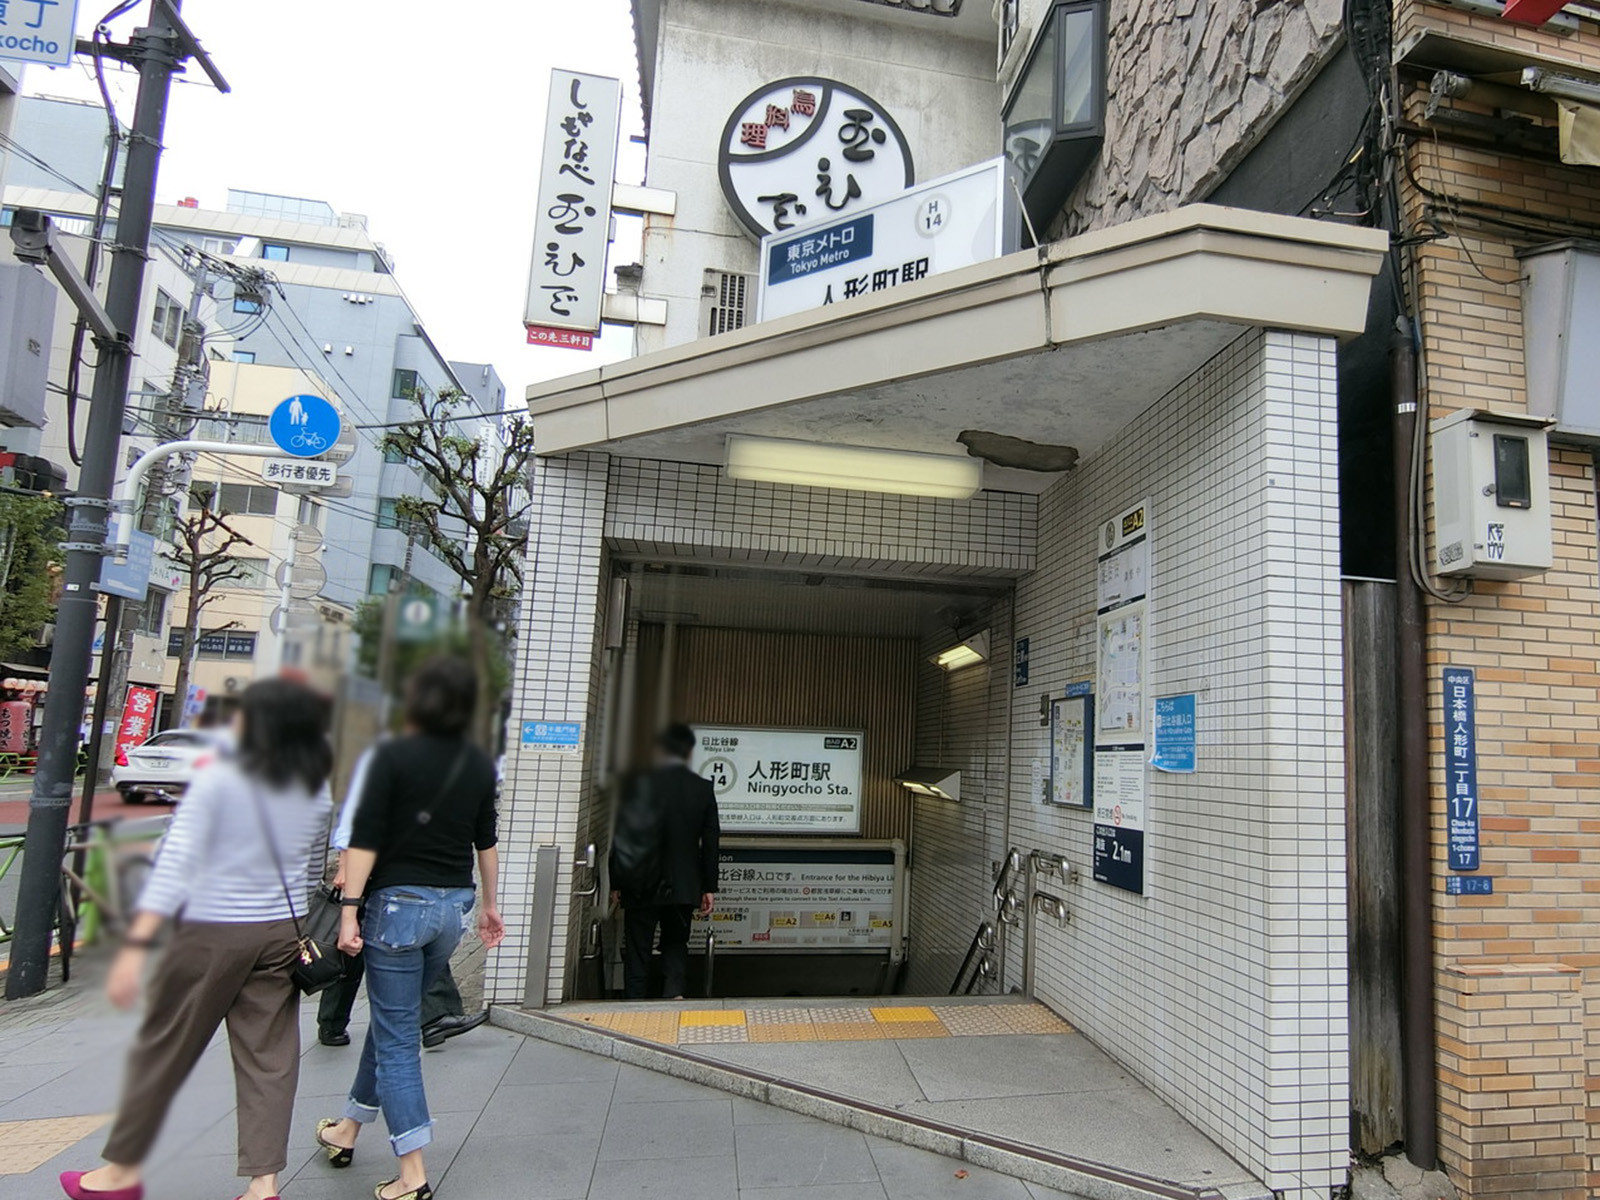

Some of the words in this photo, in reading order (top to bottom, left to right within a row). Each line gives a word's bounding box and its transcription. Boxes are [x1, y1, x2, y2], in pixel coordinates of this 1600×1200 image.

[741, 89, 816, 150] 鳥料理
[928, 200, 938, 213] H
[926, 213, 942, 229] 14
[787, 227, 855, 262] 東京メトロ
[790, 257, 818, 275] Tokyo
[819, 249, 850, 267] Metro
[267, 463, 331, 481] 歩行者優先
[1448, 676, 1470, 684] 中央区
[701, 736, 739, 747] 日比谷線
[841, 738, 857, 749] A2
[1452, 686, 1469, 795] 日本橋人形町一丁目
[713, 763, 724, 774] H
[748, 760, 831, 781] 人形町駅
[747, 782, 823, 797] Ningyocho
[827, 783, 853, 796] Sta.
[1451, 797, 1474, 818] 17
[1459, 853, 1471, 864] 17
[801, 873, 833, 882] Entrance
[835, 874, 846, 882] for
[848, 874, 860, 882] the
[861, 874, 885, 884] Hibiya
[785, 917, 797, 926] A2
[824, 913, 836, 921] A6
